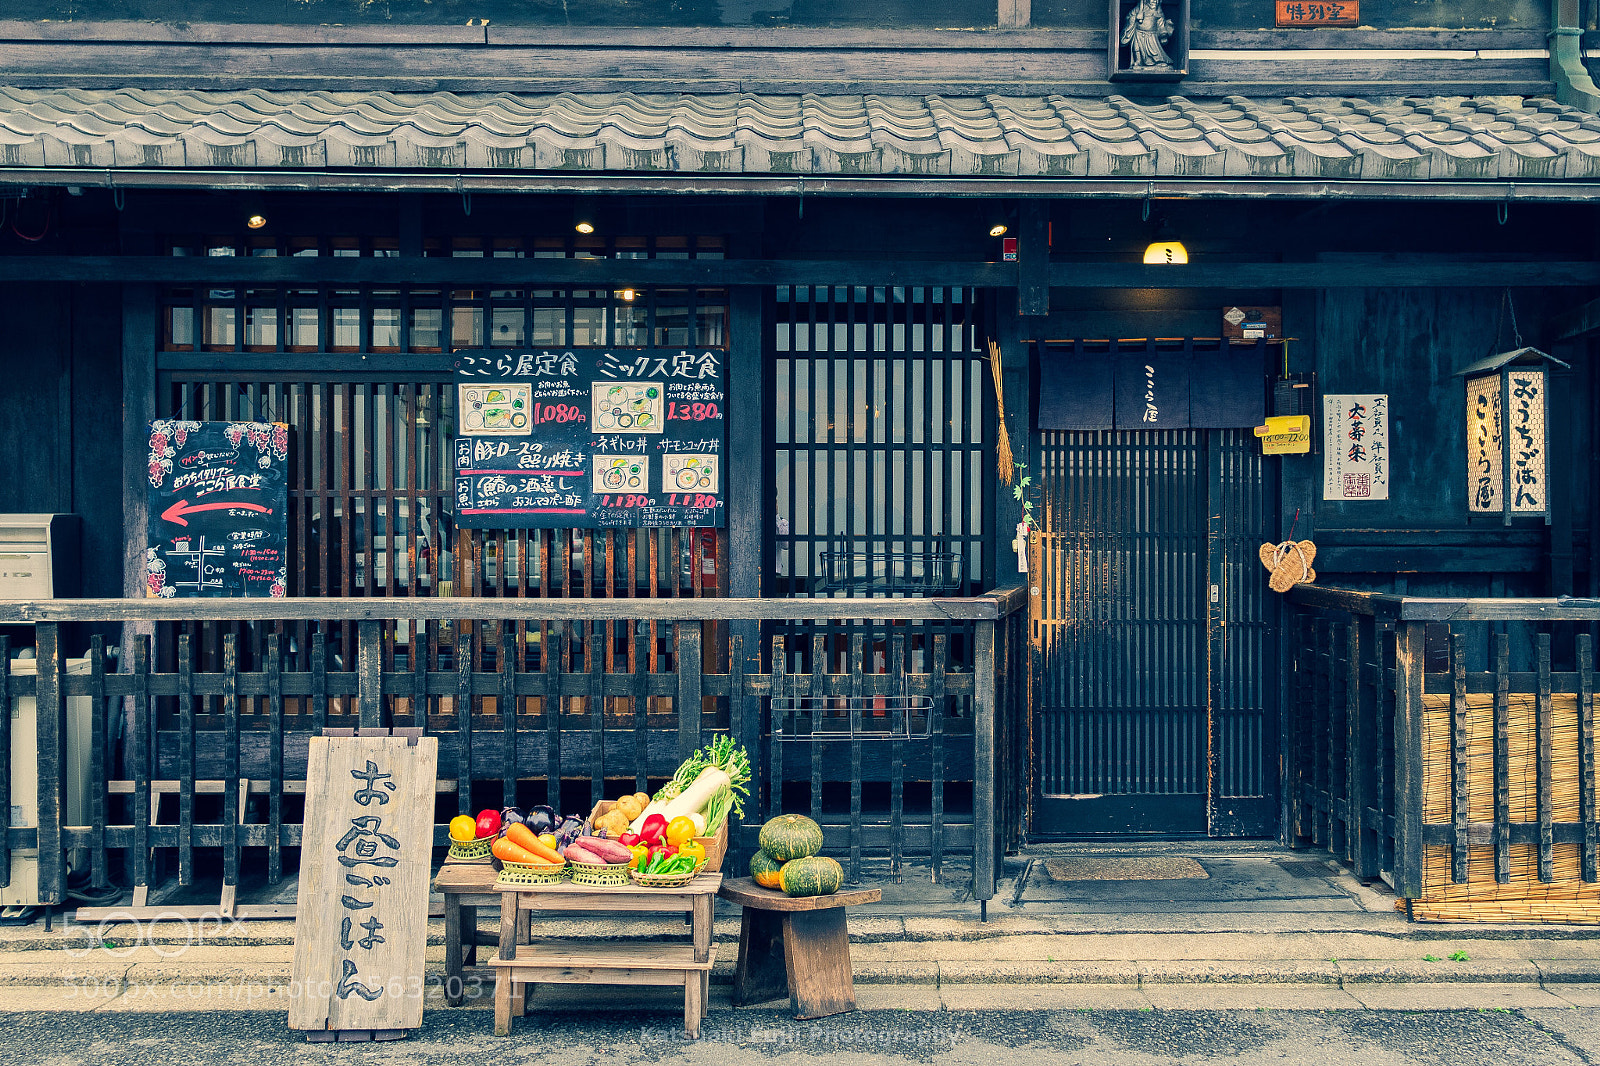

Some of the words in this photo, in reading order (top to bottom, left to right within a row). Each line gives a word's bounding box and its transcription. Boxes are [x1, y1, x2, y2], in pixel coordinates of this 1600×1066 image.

[1286, 3, 1348, 20] 特別室
[459, 351, 579, 377] ここら屋定食
[600, 351, 720, 379] ミックス定食
[1143, 365, 1158, 422] ここら屋
[596, 435, 648, 453] ネギトロ丼
[1347, 402, 1367, 462] 大募集
[1513, 377, 1538, 508] おうちごはん
[458, 443, 470, 467] お肉
[474, 440, 543, 461] 豚ロースの
[517, 449, 586, 469] 照り焼き
[173, 467, 234, 488] おうちイタリアン
[458, 481, 472, 507] お魚
[336, 760, 401, 1001] お昼ごはん
